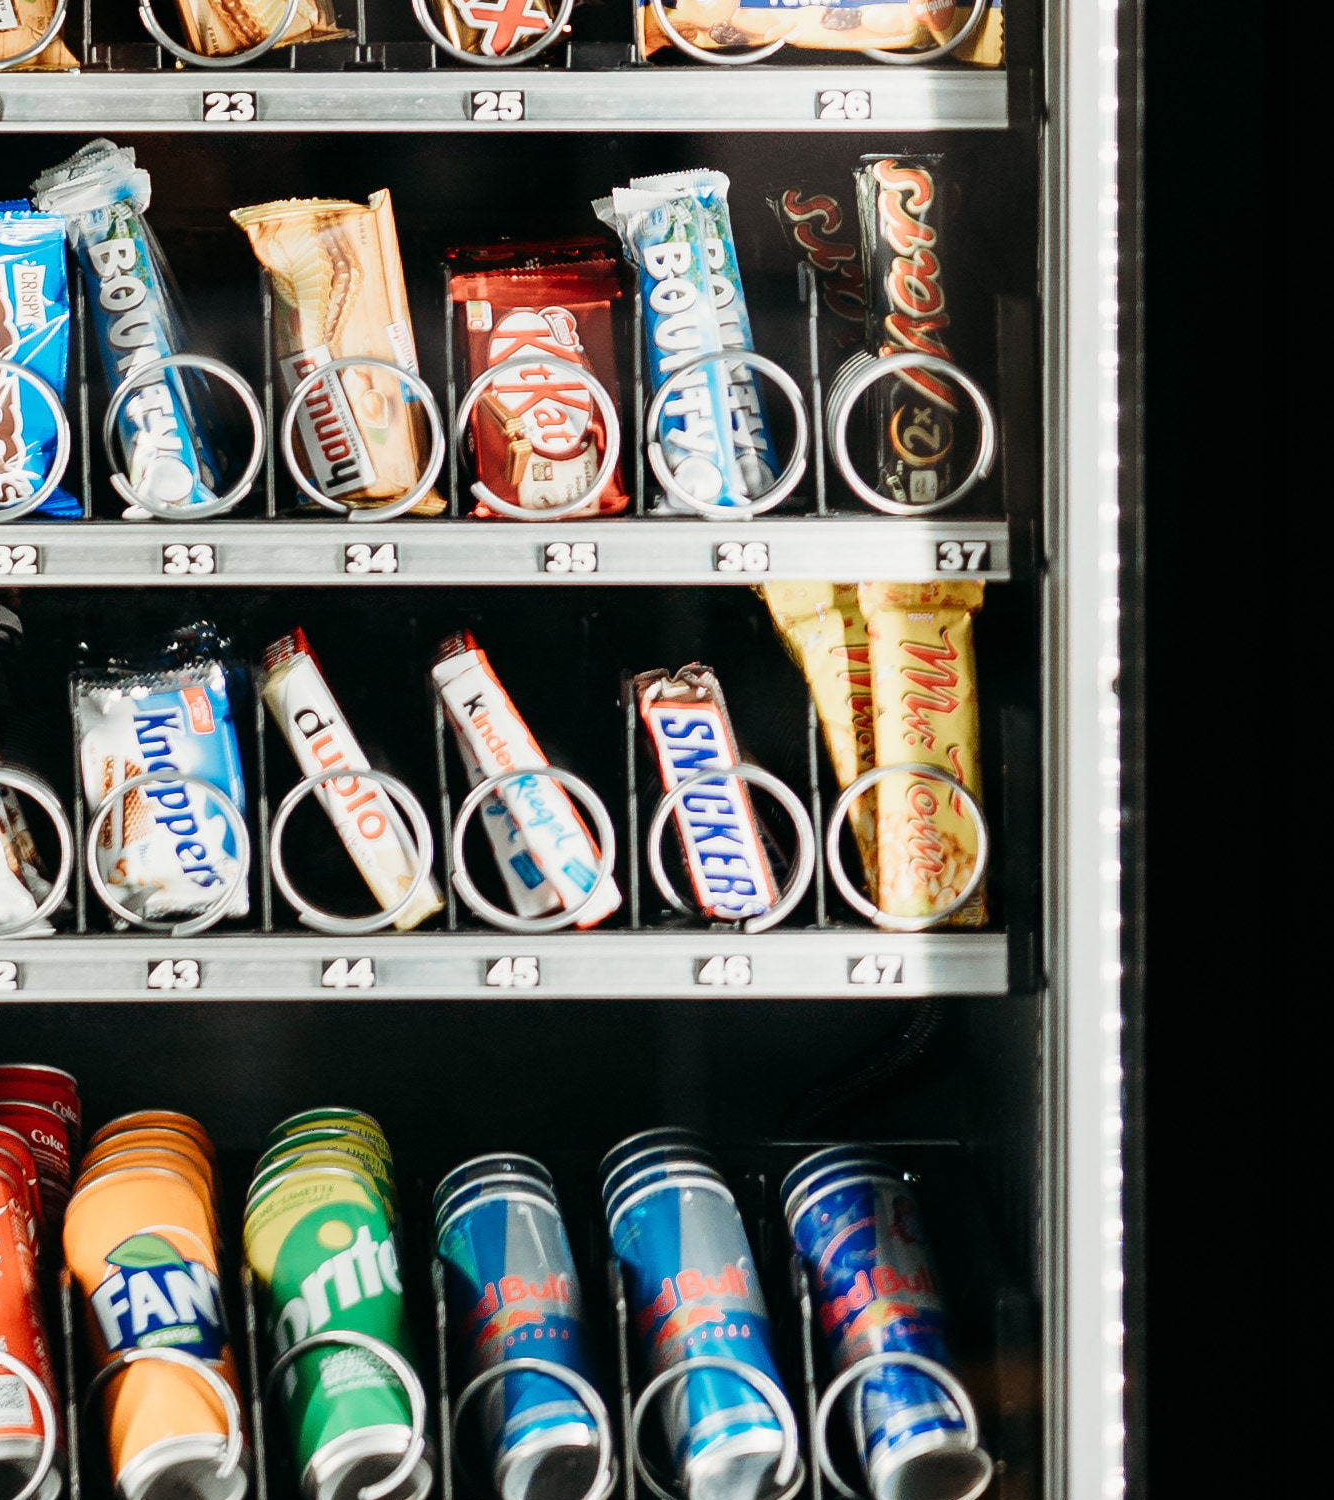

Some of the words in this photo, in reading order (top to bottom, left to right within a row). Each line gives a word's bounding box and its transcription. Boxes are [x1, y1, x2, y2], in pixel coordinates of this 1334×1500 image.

[204, 92, 256, 122] 23
[472, 92, 524, 122] 25
[819, 90, 871, 120] 26
[18, 271, 40, 321] CRISPY
[87, 239, 183, 451] BOUNTY
[643, 242, 719, 454] BOUNTY
[488, 329, 593, 446] KtKat
[163, 545, 215, 574] 33
[345, 543, 398, 572] 34
[545, 542, 597, 572] 35
[717, 542, 769, 571] 36
[939, 542, 986, 570] 37
[294, 707, 389, 842] duplo
[132, 706, 226, 889] Knoppers
[506, 774, 577, 849] Riegel
[148, 960, 201, 989] 43
[322, 956, 376, 988] 44
[485, 956, 539, 988] 45
[697, 955, 753, 985] 46
[849, 955, 904, 984] 47
[498, 1272, 573, 1304] Bull
[676, 1262, 750, 1304] Bull
